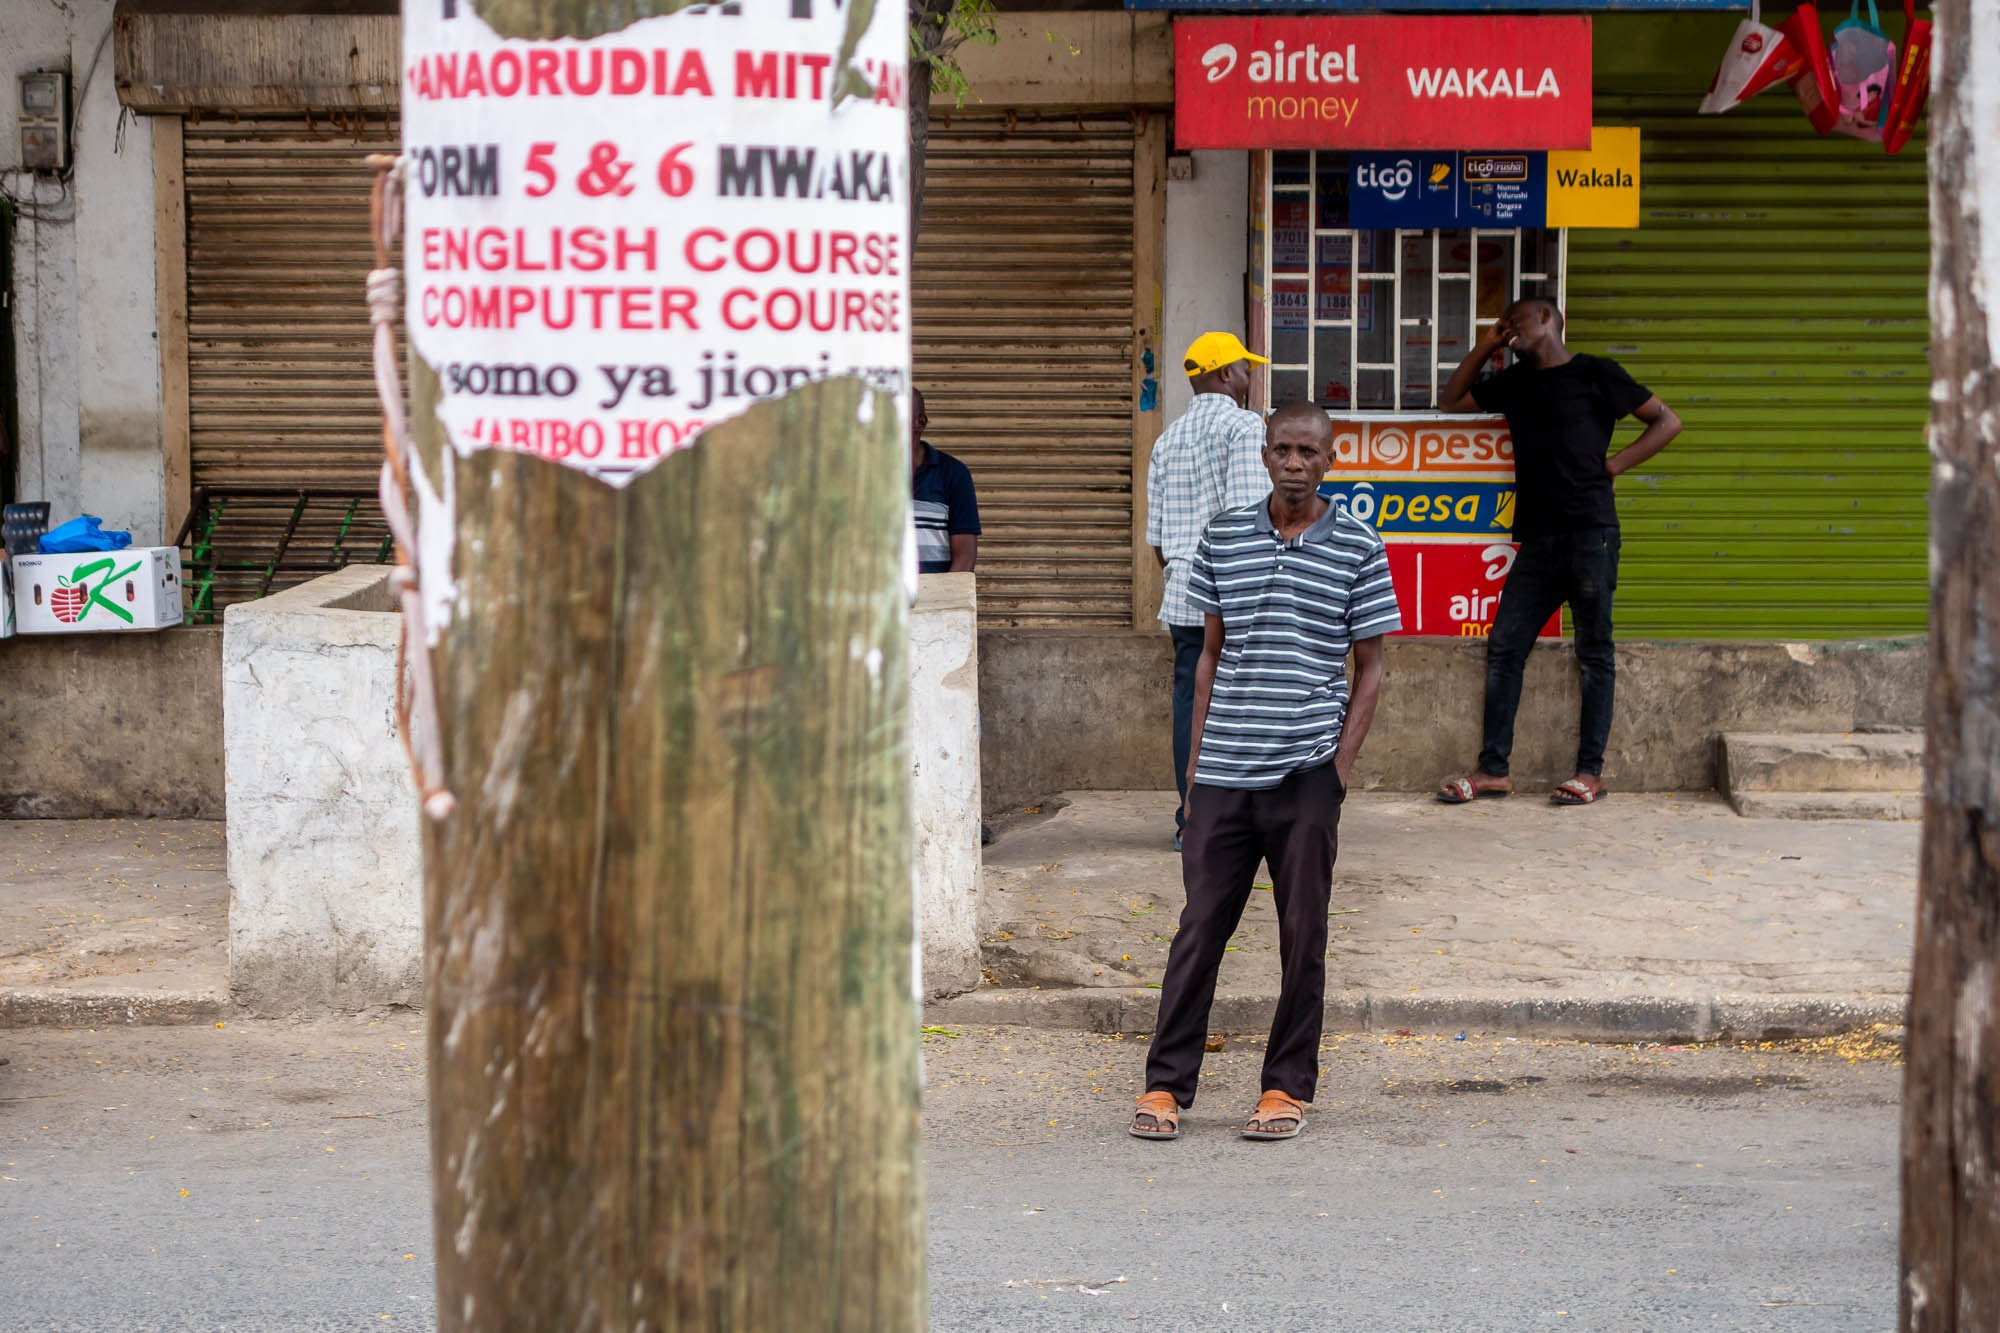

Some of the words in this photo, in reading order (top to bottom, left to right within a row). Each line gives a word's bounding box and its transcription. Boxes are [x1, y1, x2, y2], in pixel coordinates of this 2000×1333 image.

[1247, 40, 1360, 83] airtel
[1406, 67, 1561, 98] WAKALA
[1246, 96, 1360, 127] money
[411, 144, 499, 198] ORM
[523, 141, 558, 199] 5
[576, 140, 636, 199] &
[657, 141, 696, 199] 6
[1556, 168, 1634, 188] Wakala
[422, 227, 657, 272] ENGLISH
[683, 228, 900, 277] COURSE
[421, 286, 700, 331] COMPUTER
[721, 288, 901, 333] COURSE
[602, 363, 676, 410] ya
[465, 417, 605, 461] ABIBO
